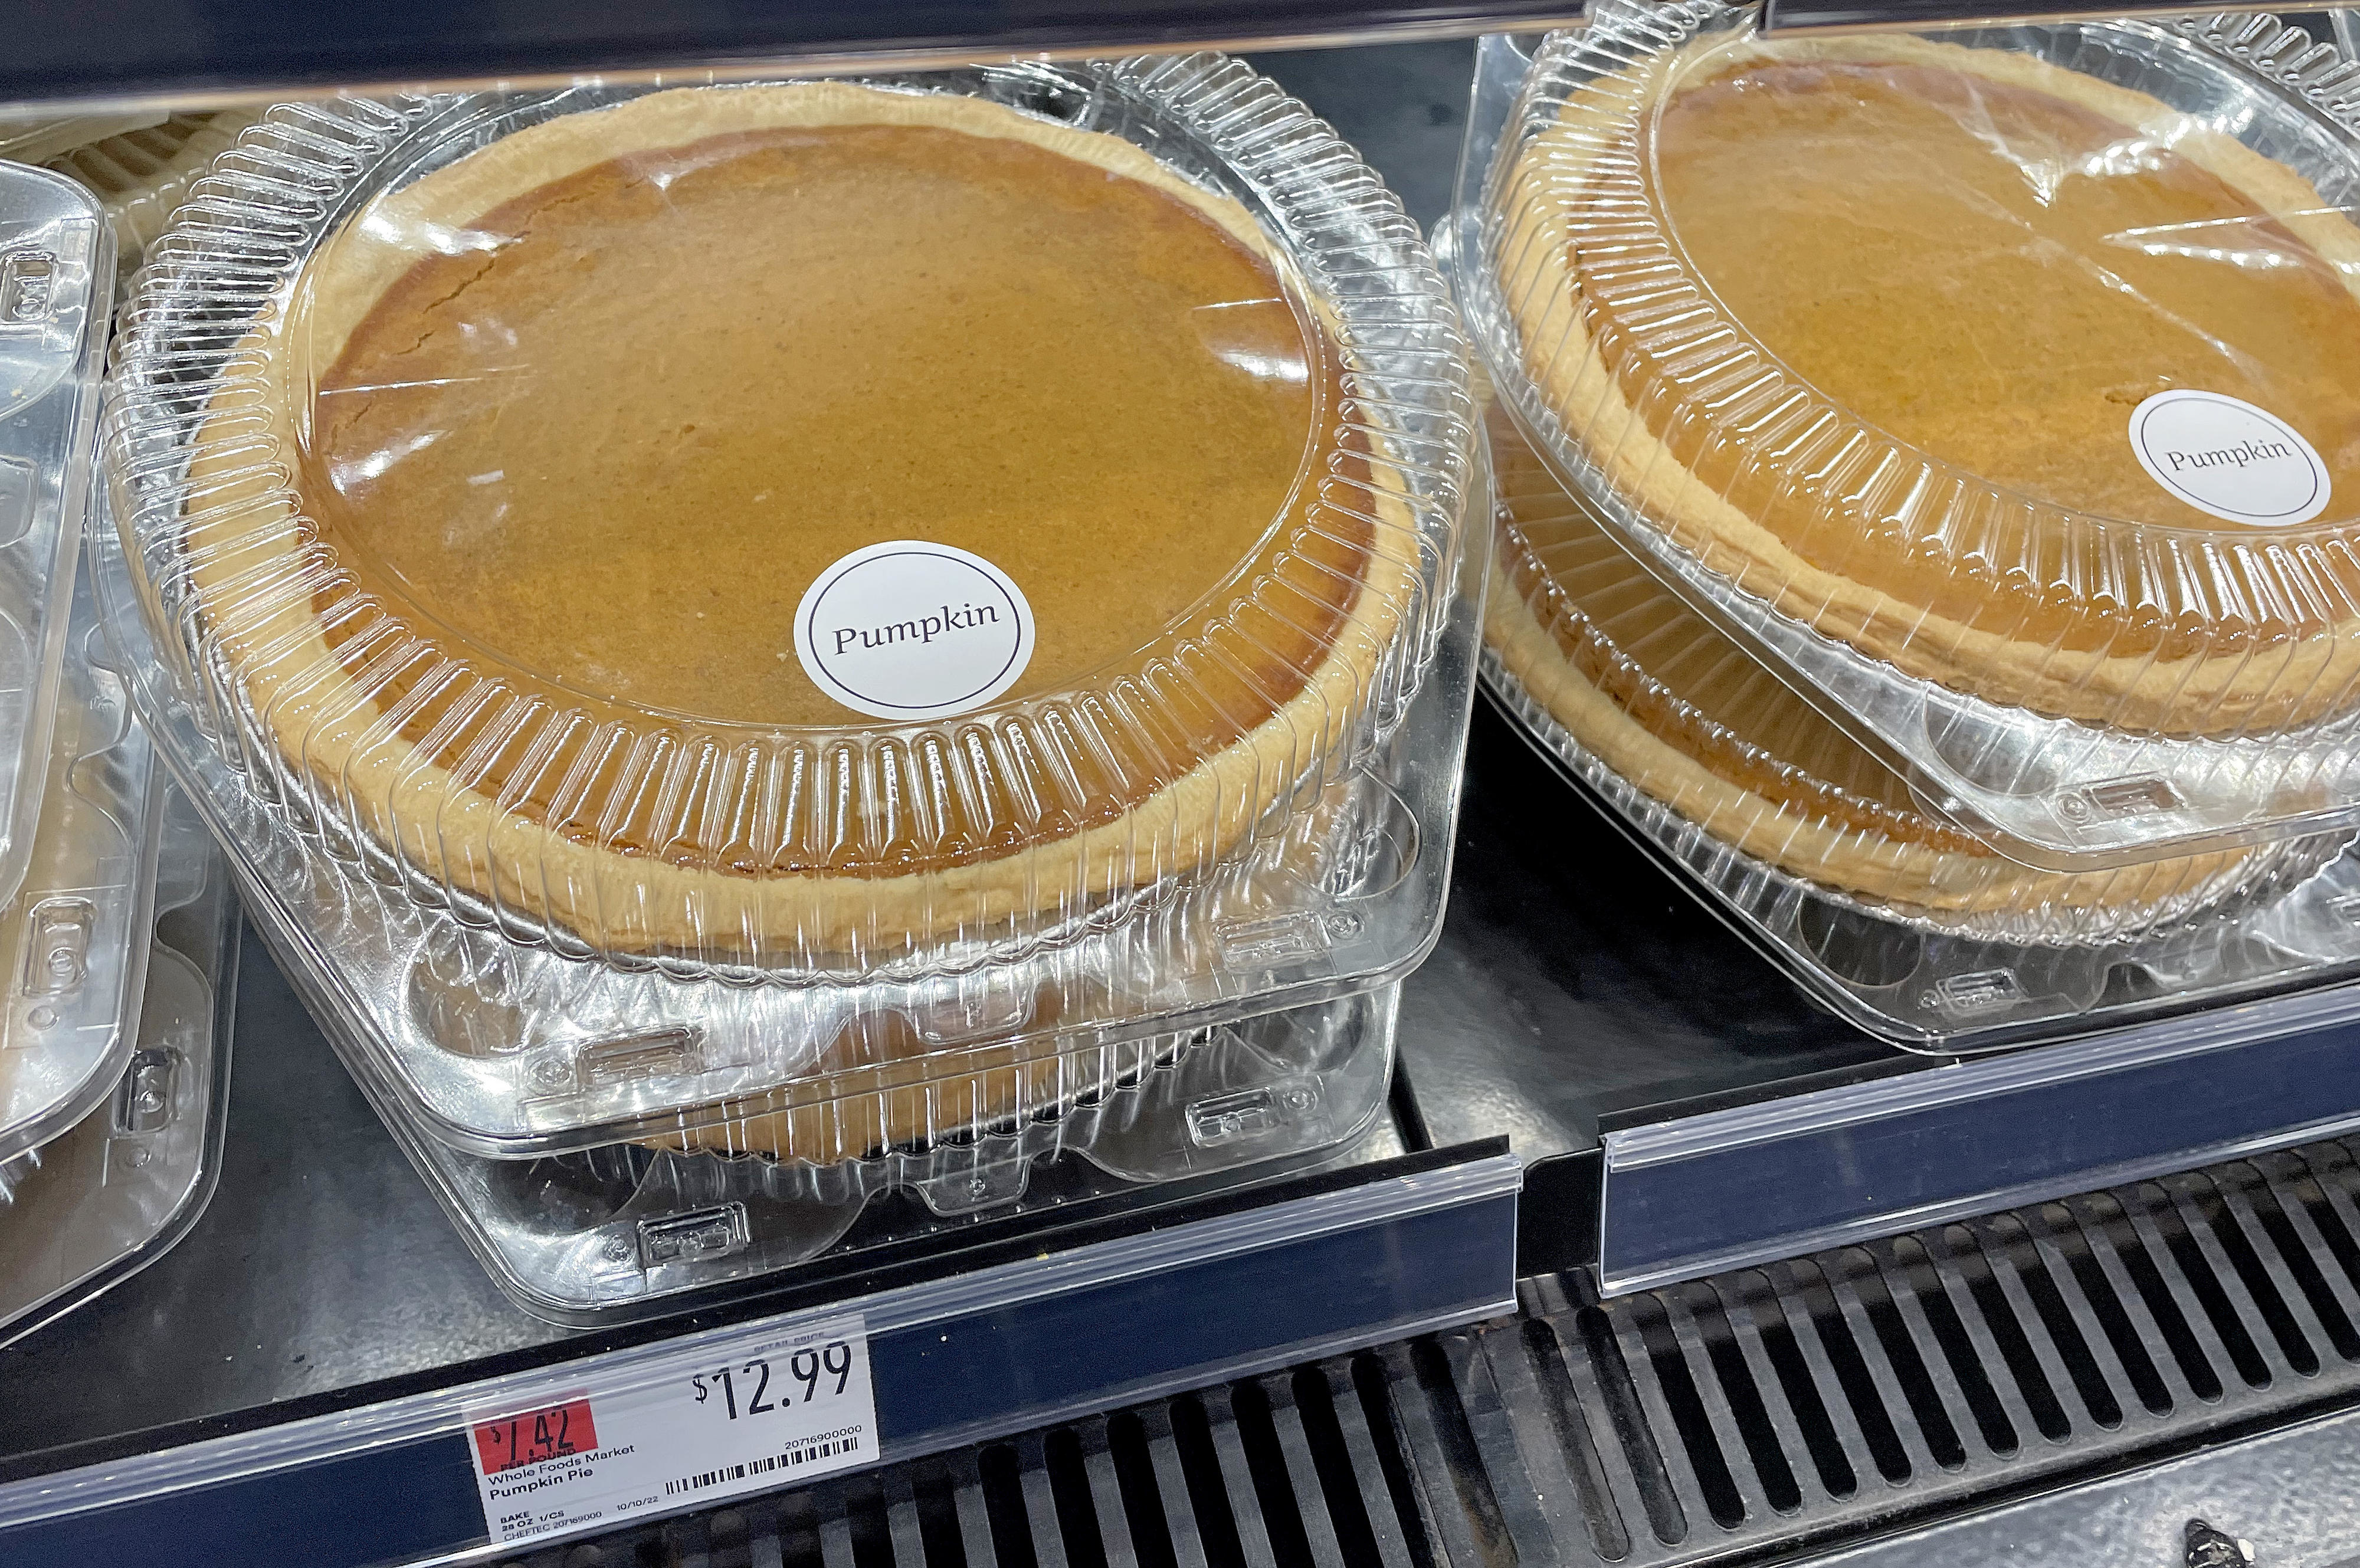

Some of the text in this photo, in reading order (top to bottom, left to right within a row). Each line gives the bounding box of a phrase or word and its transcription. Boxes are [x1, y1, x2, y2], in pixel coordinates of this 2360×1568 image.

[2165, 439, 2293, 471] Pumpkin
[832, 602, 1001, 655] Pumpkin
[693, 1341, 851, 1420] $12.99
[785, 1425, 862, 1450] 20716900000
[488, 1445, 635, 1485] Whole Foods Market
[529, 1448, 576, 1464] POUND
[490, 1467, 593, 1500] Pumpkin Pie
[500, 1511, 530, 1524] BAKE
[617, 1496, 658, 1511] 10/10/22
[504, 1511, 602, 1541] CHEFTEC 207169000
[517, 1518, 533, 1527] OZ
